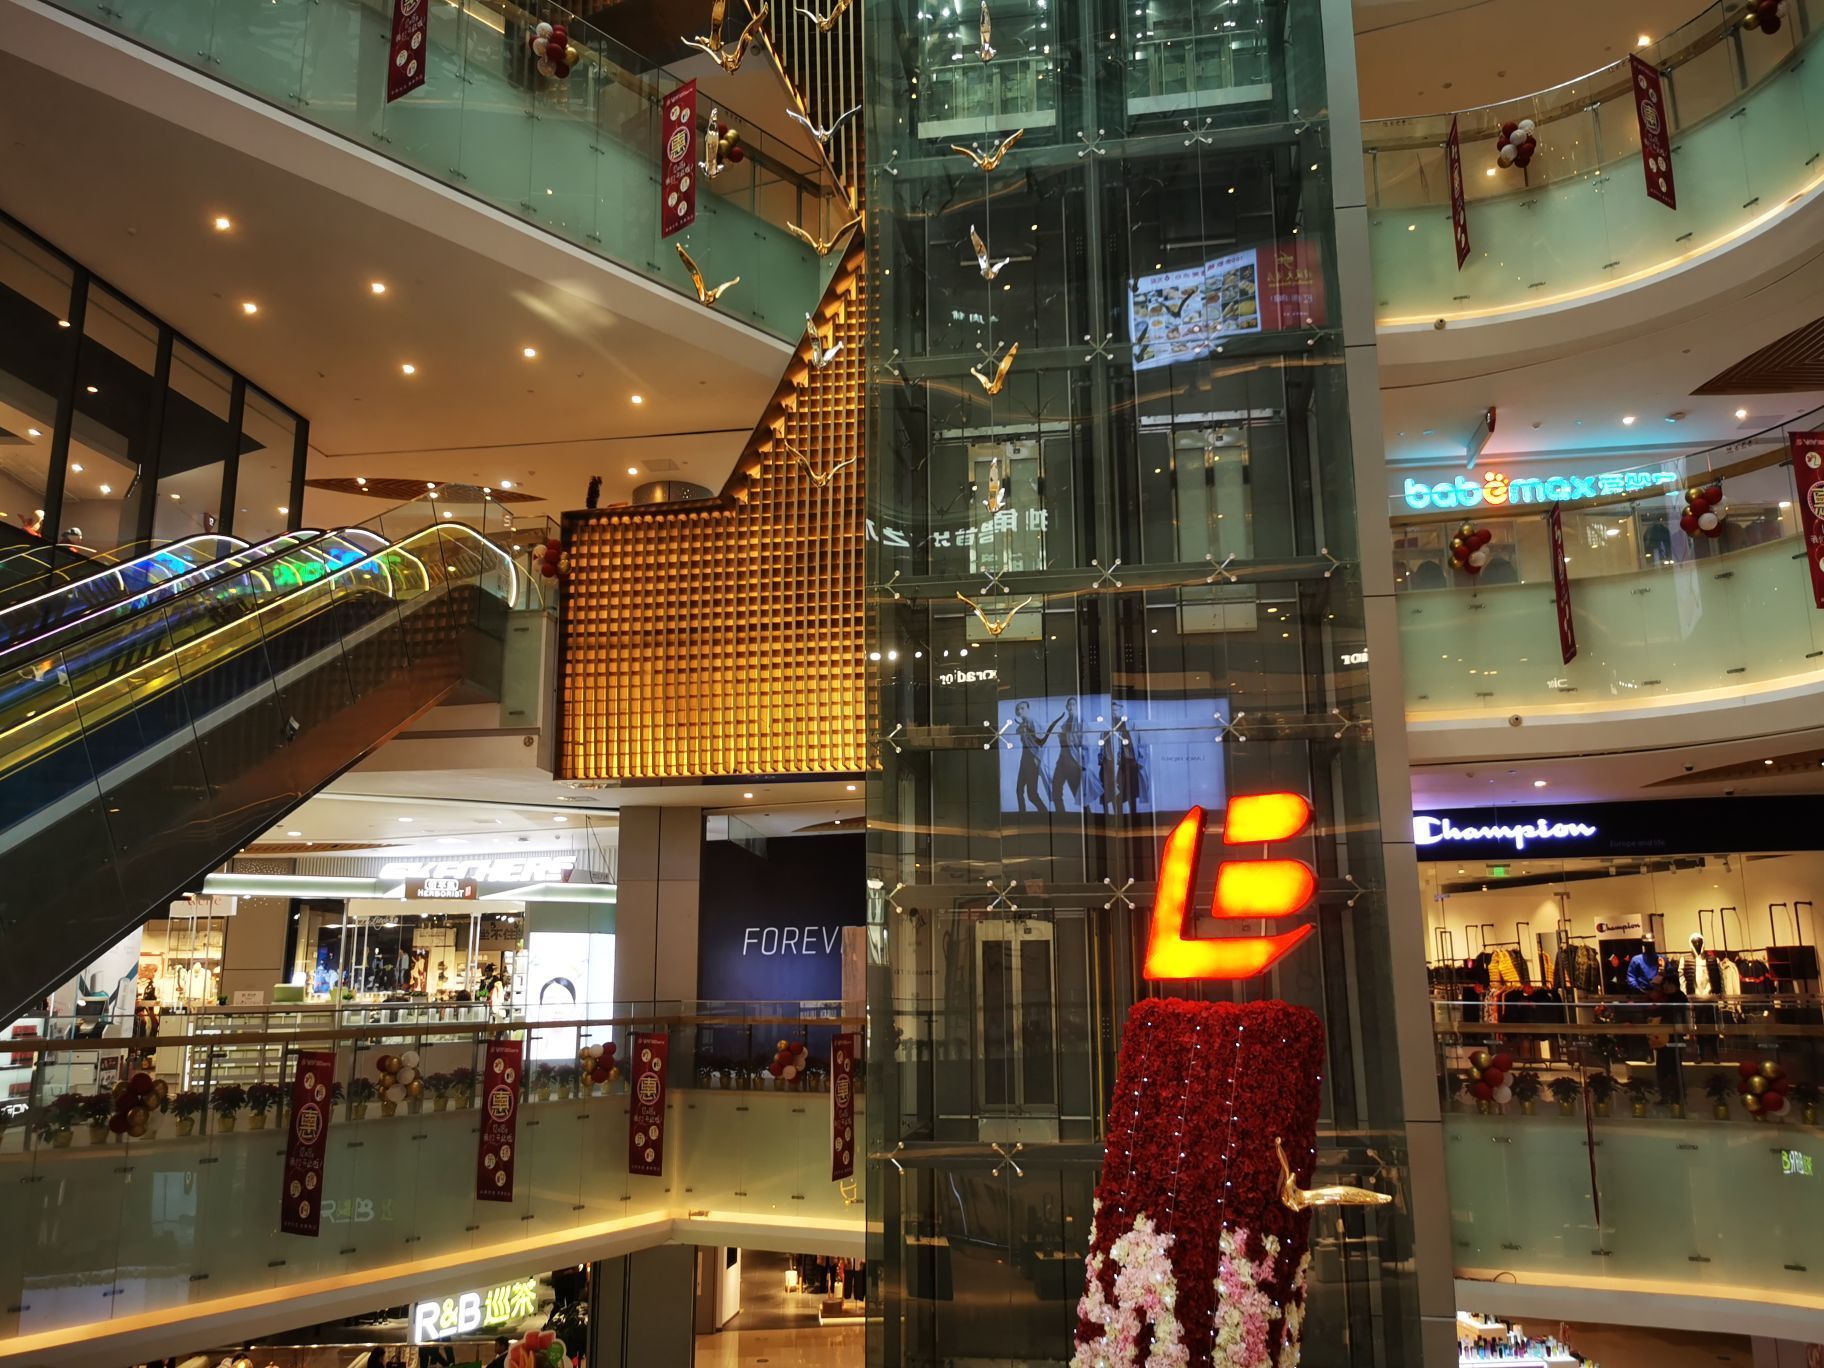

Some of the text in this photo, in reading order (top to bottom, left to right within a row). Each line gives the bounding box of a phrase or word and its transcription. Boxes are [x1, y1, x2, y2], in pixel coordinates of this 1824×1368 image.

[1403, 471, 1597, 509] babemax
[1413, 815, 1597, 850] Champion
[417, 889, 465, 898] HERBORIST
[743, 926, 842, 956] FOREV
[1596, 923, 1641, 935] Champion
[414, 1278, 537, 1345] R&B 巡茶
